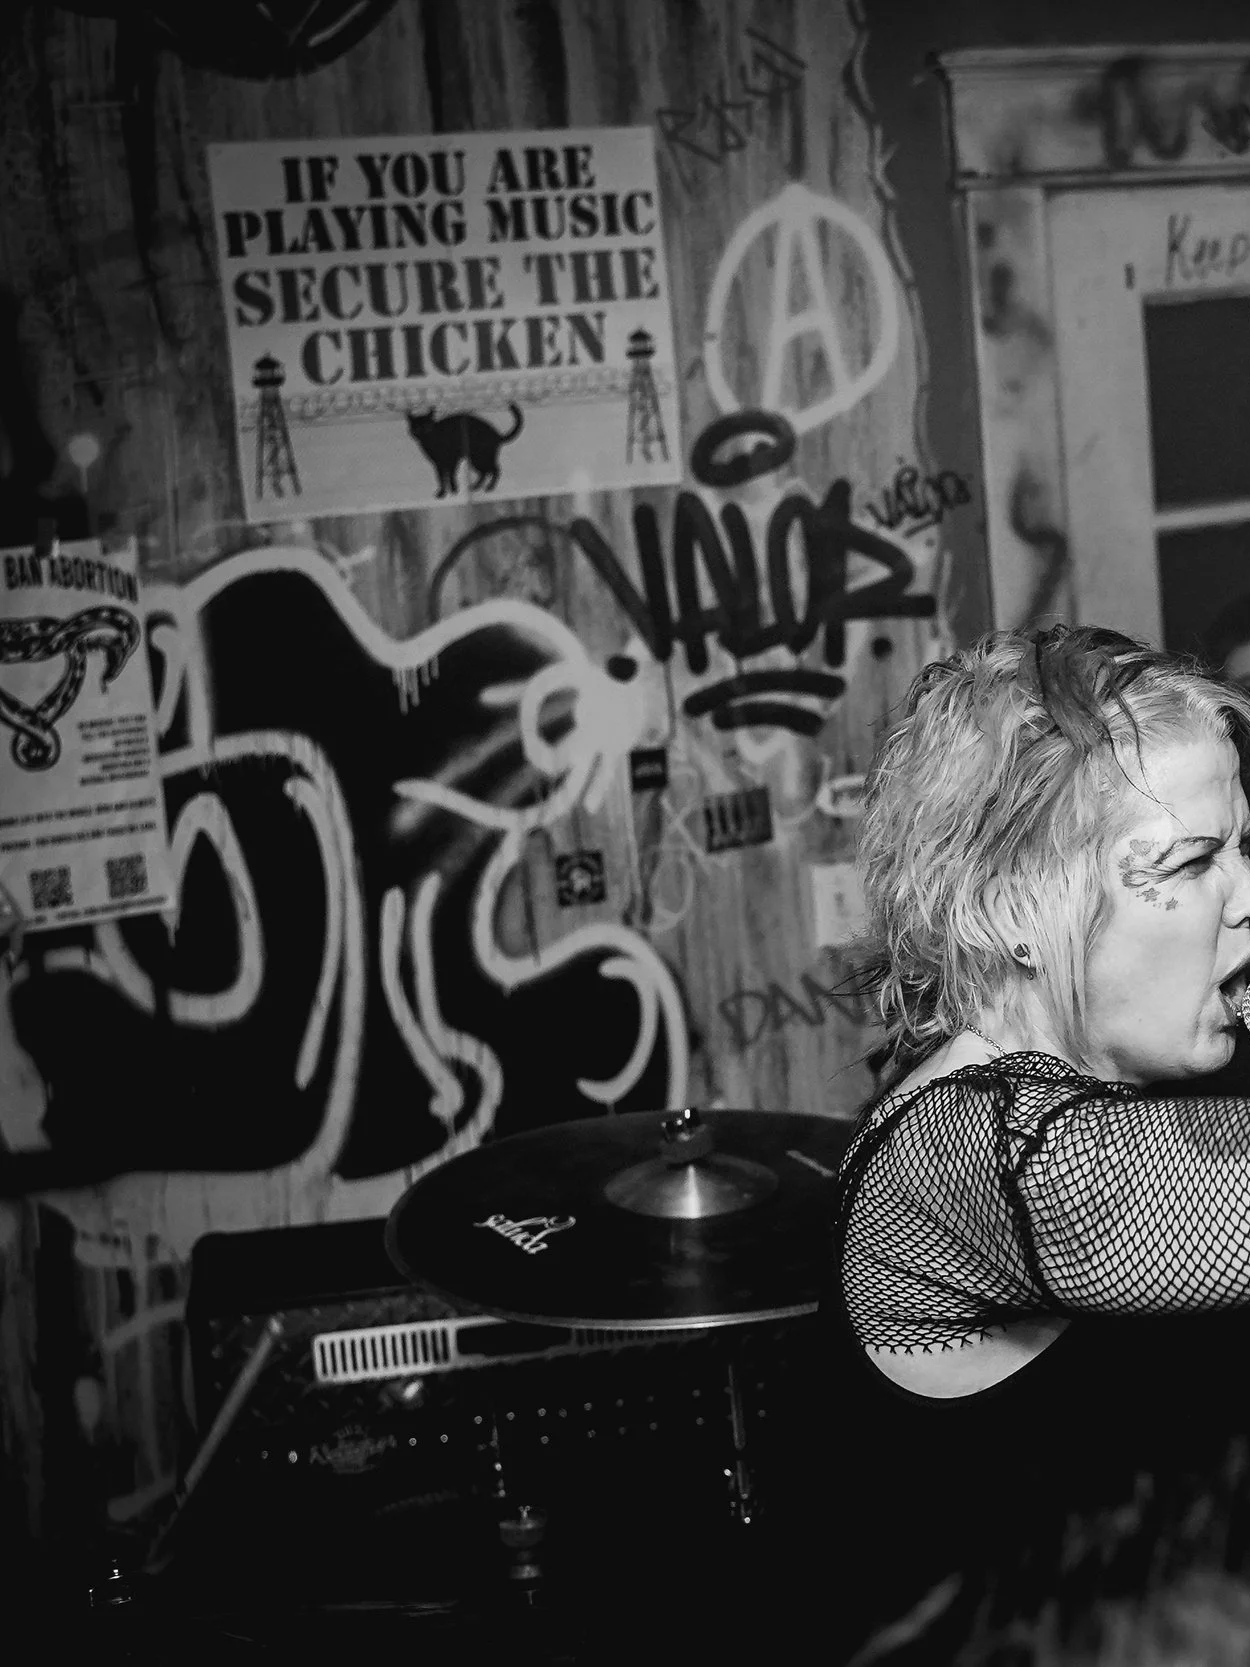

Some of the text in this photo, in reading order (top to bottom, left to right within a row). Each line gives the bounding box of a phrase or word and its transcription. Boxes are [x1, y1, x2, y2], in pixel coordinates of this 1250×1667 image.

[281, 145, 595, 203] IF YOU ARE
[224, 191, 655, 257] PLAYING MUSIC
[1164, 213, 1250, 286] Keep
[234, 247, 660, 327] SECURE THE
[302, 311, 607, 385] CHICKEN
[5, 556, 138, 603] BAN ABORTION
